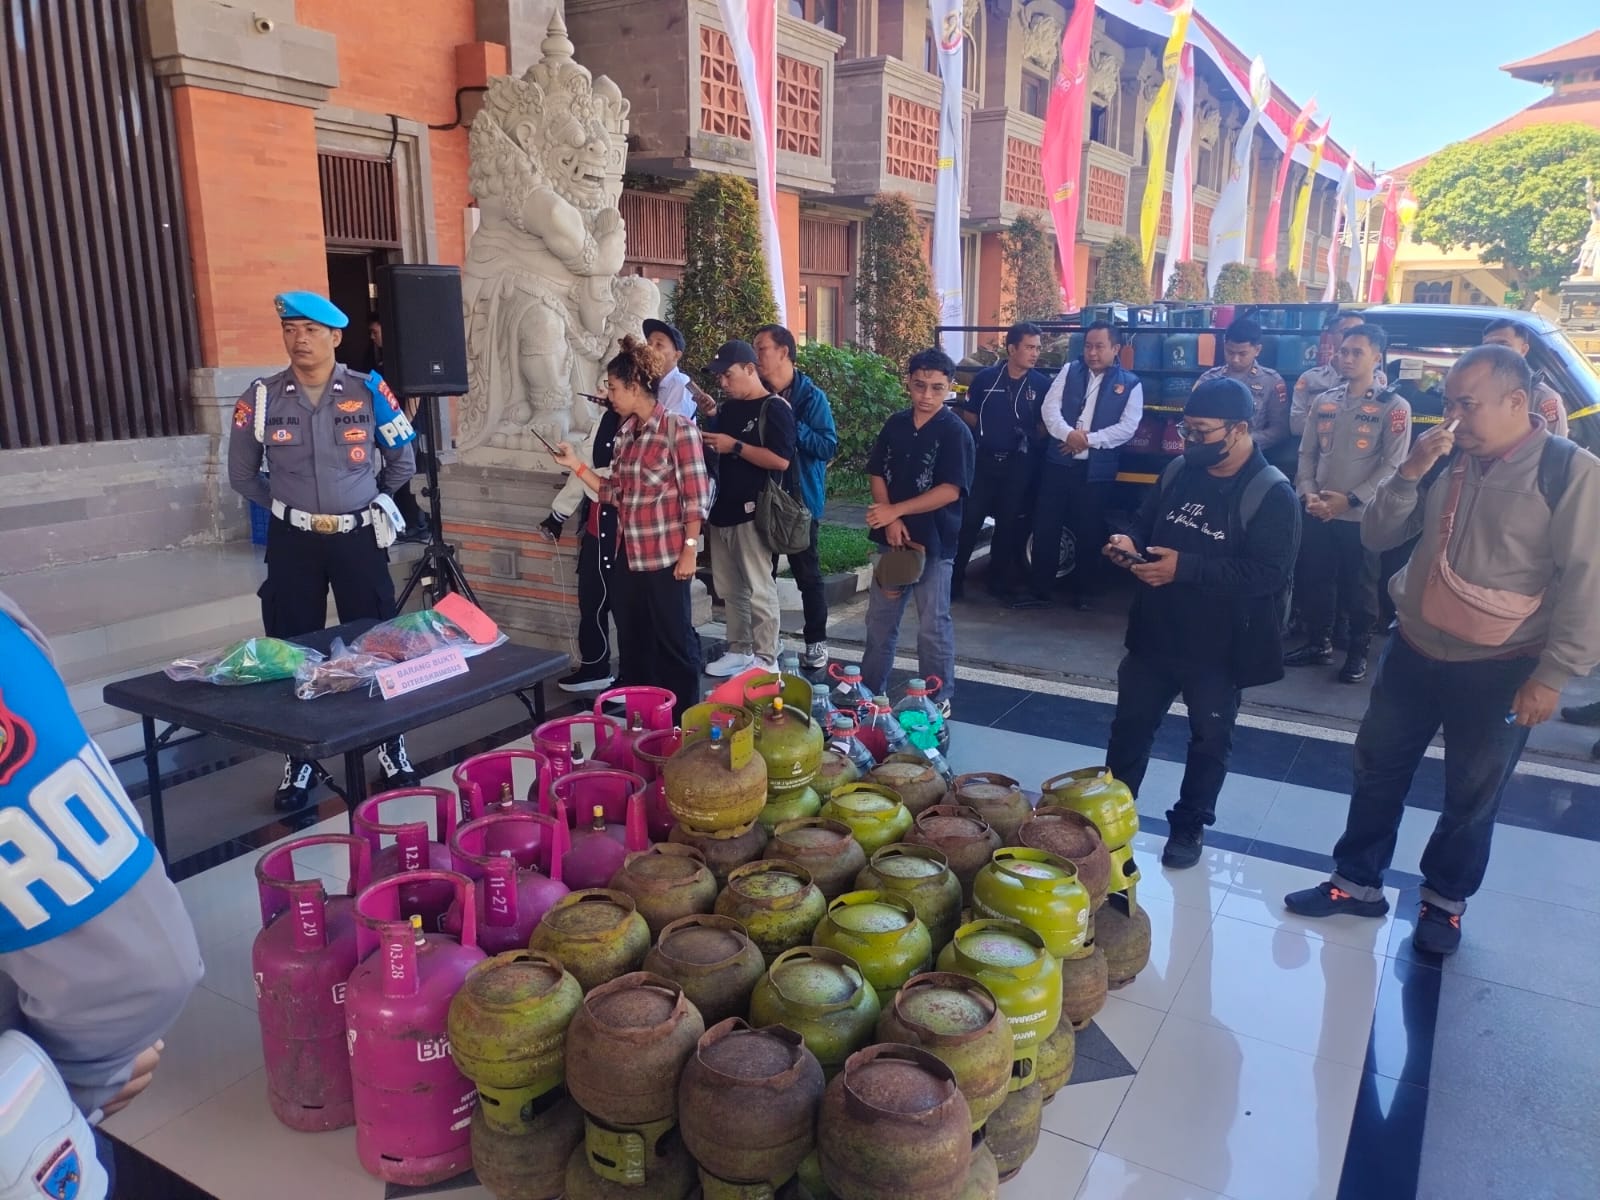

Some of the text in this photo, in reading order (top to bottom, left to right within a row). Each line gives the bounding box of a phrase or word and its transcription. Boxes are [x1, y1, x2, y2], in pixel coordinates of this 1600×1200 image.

[334, 414, 370, 426] POLRI
[396, 653, 457, 679] BARANG BUKTI
[405, 845, 420, 872] 12.3
[490, 876, 508, 914] 11-27
[299, 901, 318, 937] 11.29
[390, 943, 405, 979] 03.28
